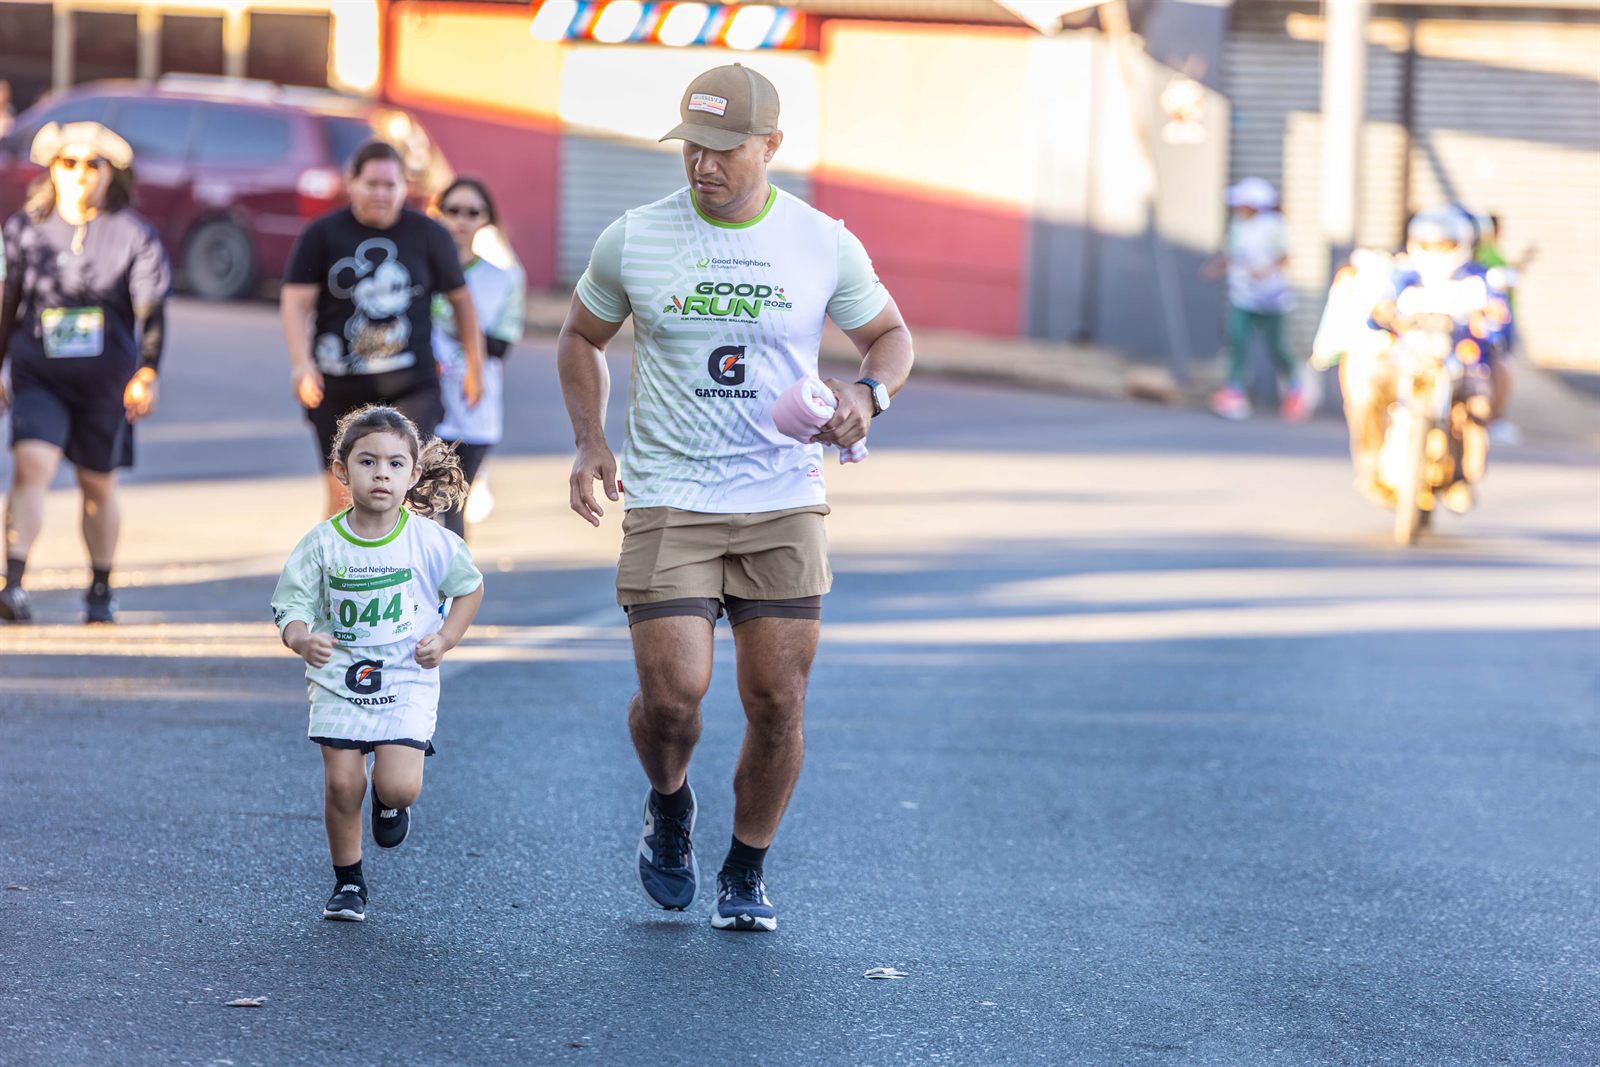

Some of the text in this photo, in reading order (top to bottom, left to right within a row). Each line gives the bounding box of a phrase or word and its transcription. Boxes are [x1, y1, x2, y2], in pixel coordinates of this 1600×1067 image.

[711, 257, 771, 268] Good Neighbors
[695, 281, 773, 299] GOOD
[682, 295, 793, 318] RUN 2026
[707, 345, 748, 386] G
[695, 388, 757, 399] GATORADE
[348, 565, 368, 573] Good
[339, 591, 403, 628] 044
[345, 659, 385, 694] G
[380, 808, 398, 818] NIKE
[340, 884, 361, 893] NIKE
